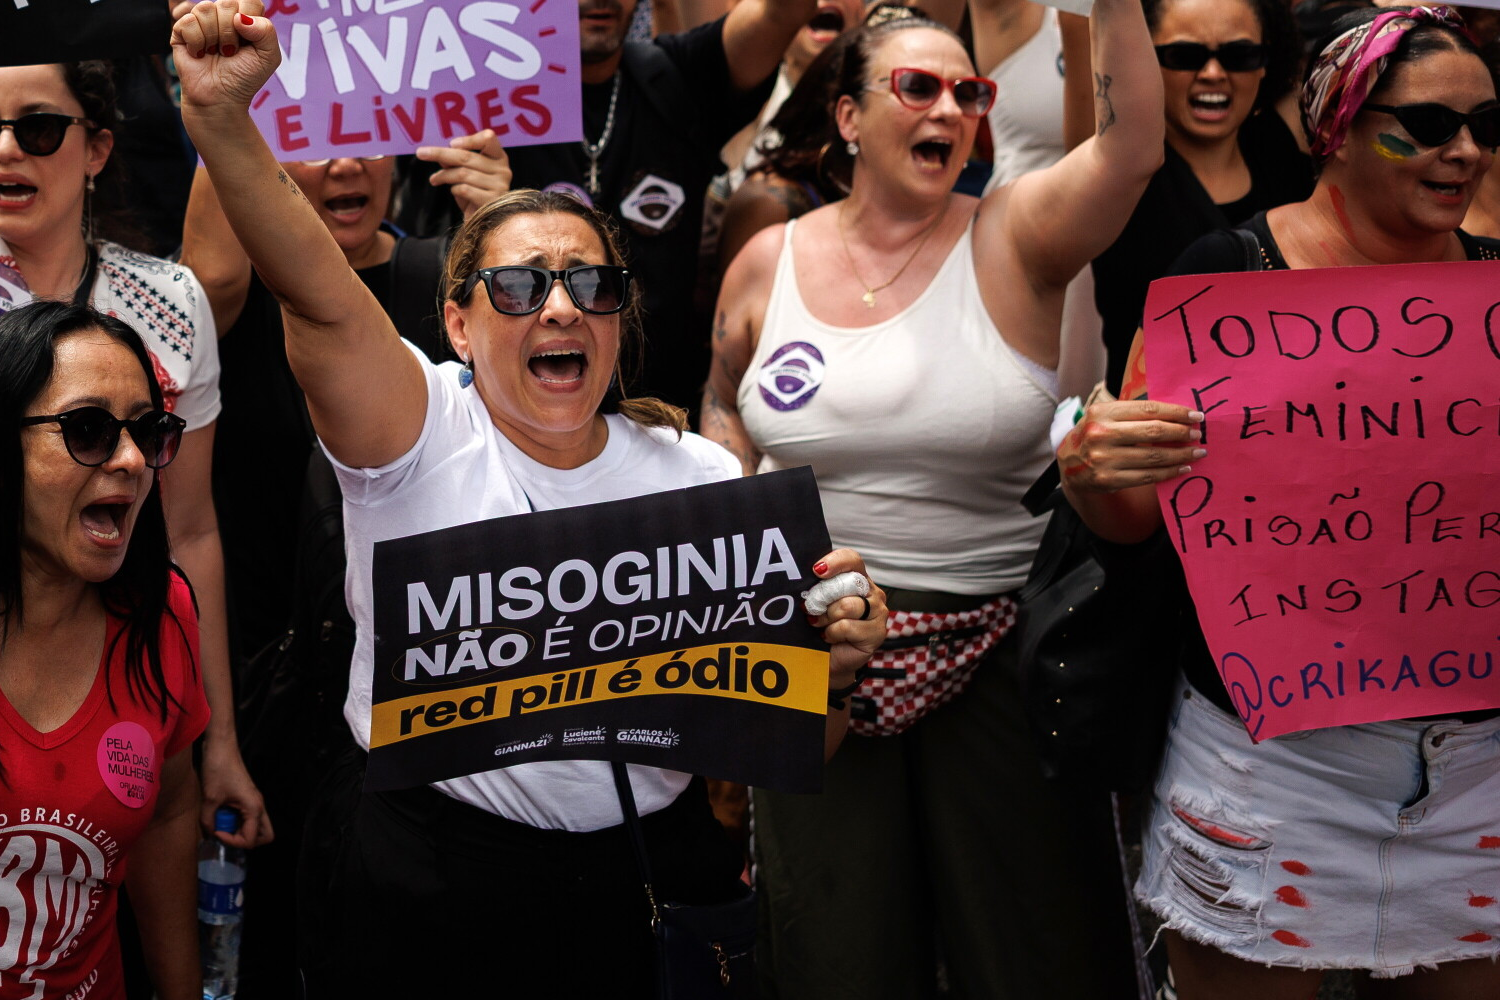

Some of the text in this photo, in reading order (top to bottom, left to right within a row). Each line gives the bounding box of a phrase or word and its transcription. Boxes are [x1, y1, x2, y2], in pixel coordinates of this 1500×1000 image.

[1153, 284, 1454, 365] TODOS
[405, 527, 803, 636] MISOGINIA
[403, 591, 795, 682] NÃO É OPINIÃO
[399, 646, 790, 737] red pill é ódio
[616, 731, 672, 746] GIANNAZI
[629, 728, 663, 737] CARLOS
[106, 737, 133, 752] PELA
[494, 738, 548, 757] GIANNAZI
[106, 750, 149, 768] VIDA DAS
